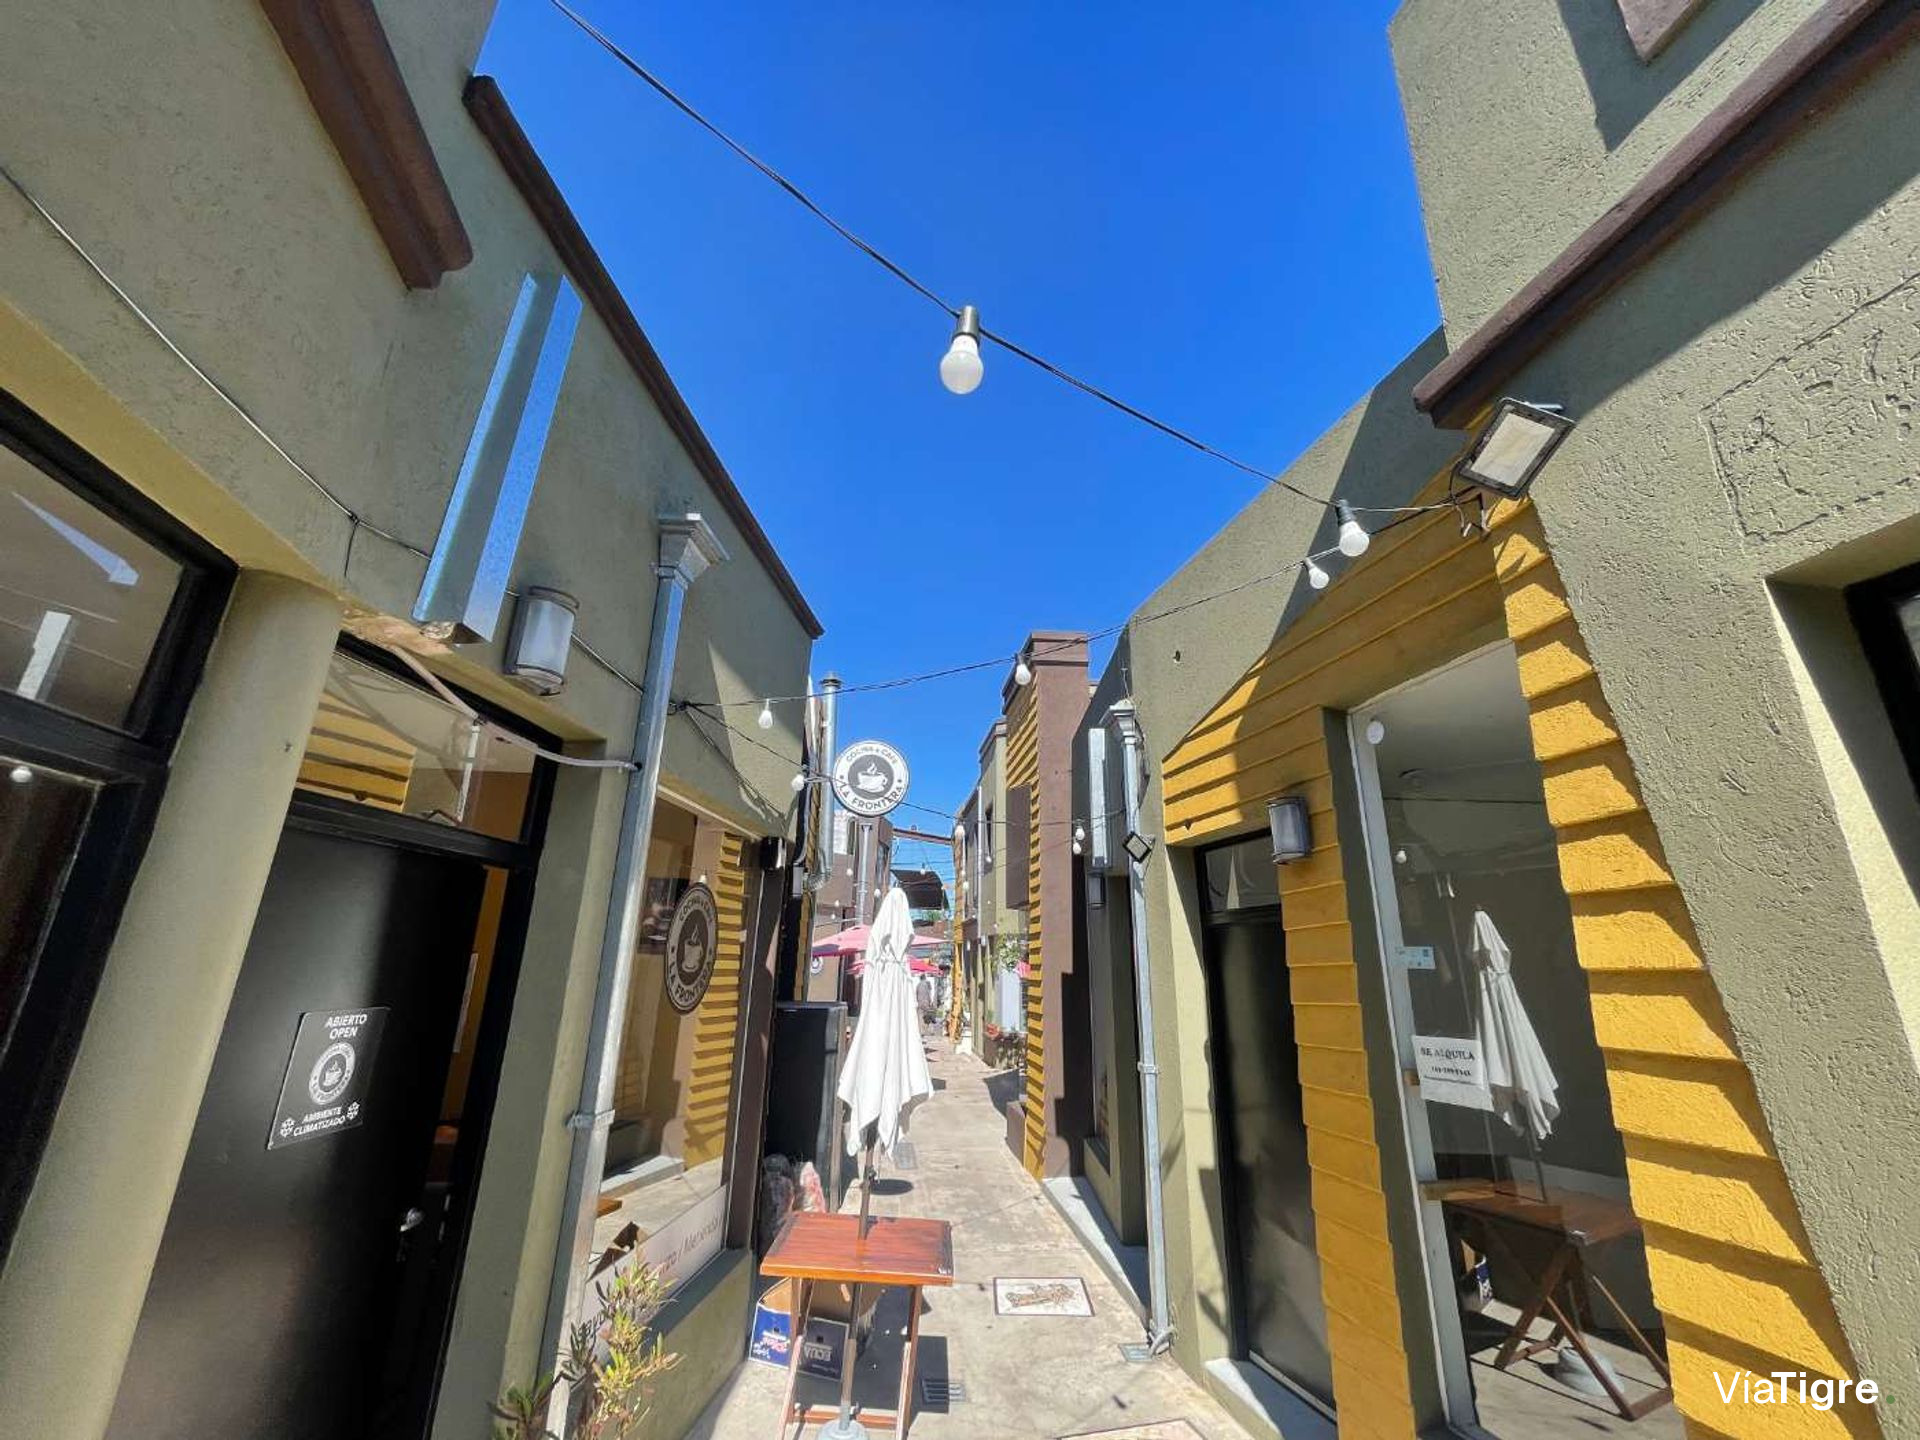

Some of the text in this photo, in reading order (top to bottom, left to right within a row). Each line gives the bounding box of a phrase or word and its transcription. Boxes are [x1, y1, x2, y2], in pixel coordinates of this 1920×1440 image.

[852, 786, 903, 810] FRONTERA
[325, 1014, 367, 1028] ABIERTO
[329, 1027, 358, 1039] OPEN
[1434, 1048, 1475, 1061] ALQUILA
[302, 1106, 343, 1124] AMBIENTE
[293, 1115, 346, 1137] CLIMATIZADO
